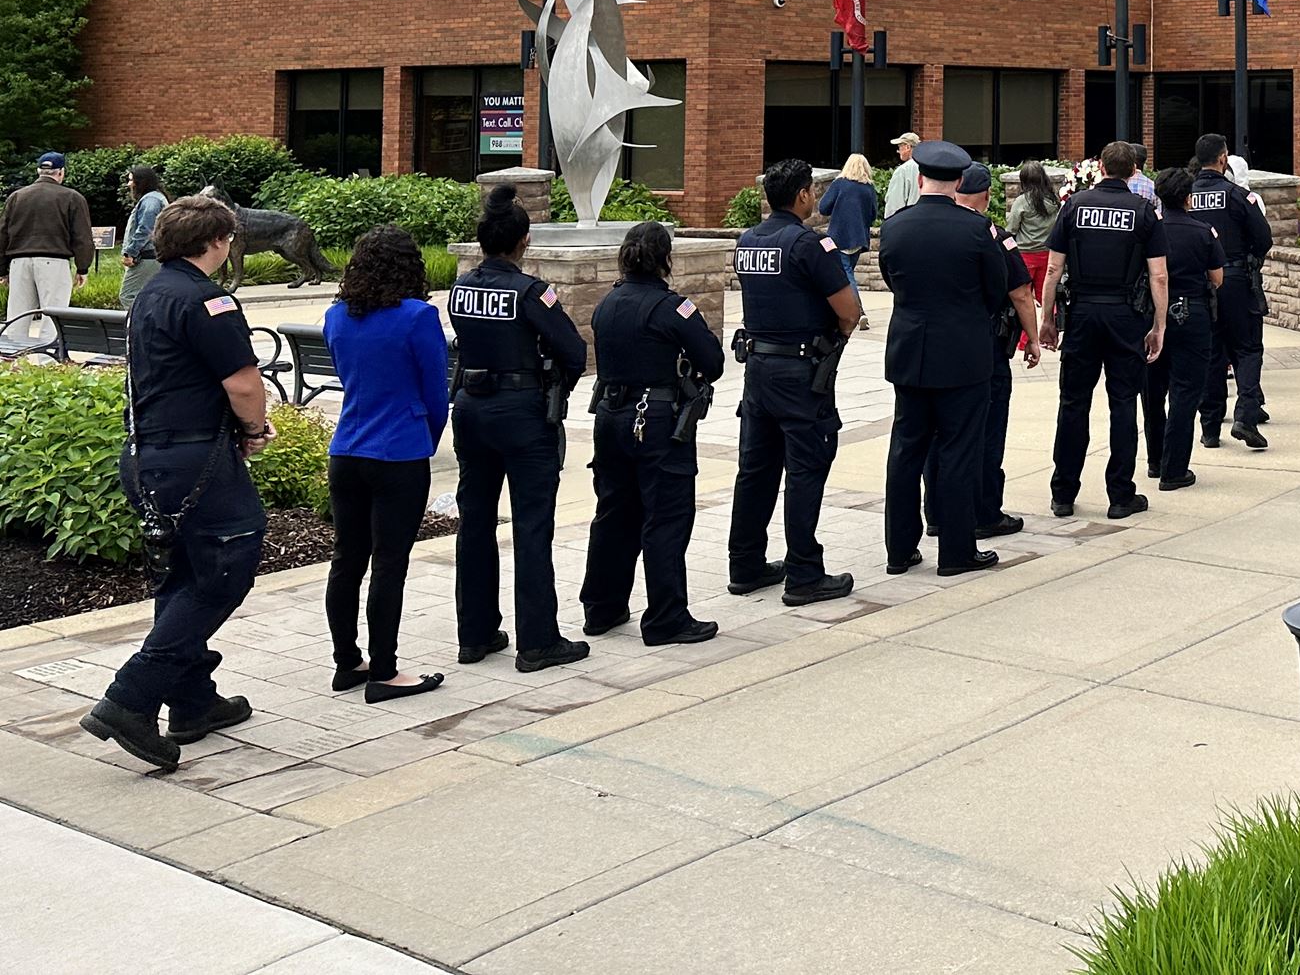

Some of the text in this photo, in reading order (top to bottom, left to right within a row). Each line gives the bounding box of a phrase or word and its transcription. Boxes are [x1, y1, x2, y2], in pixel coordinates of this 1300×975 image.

[483, 96, 500, 106] YOU
[482, 117, 497, 128] Text.
[498, 117, 513, 128] Call.
[1192, 193, 1222, 209] OLICE
[1081, 209, 1131, 229] POLICE
[737, 250, 776, 272] POLICE
[455, 289, 510, 317] POLICE
